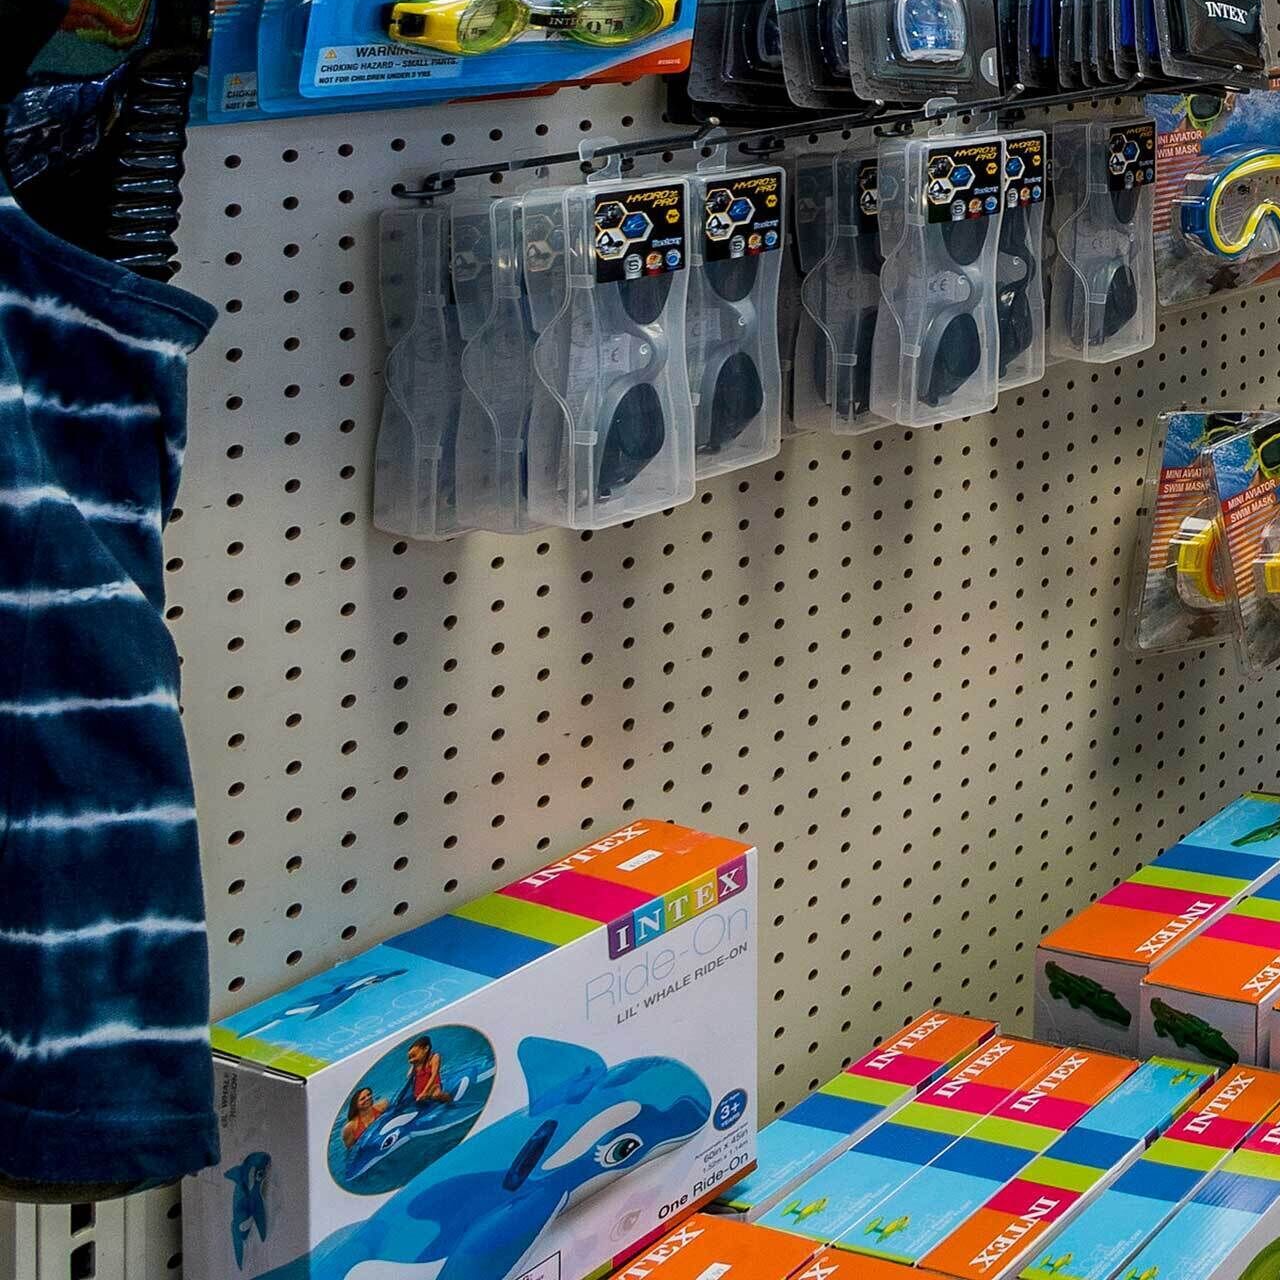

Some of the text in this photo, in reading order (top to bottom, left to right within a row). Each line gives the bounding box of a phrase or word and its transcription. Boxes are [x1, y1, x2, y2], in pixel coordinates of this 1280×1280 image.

[1205, 1, 1248, 24] INTEX
[318, 76, 333, 84] NOT
[335, 75, 350, 83] FOR
[350, 73, 386, 83] CHILDREN
[321, 61, 359, 73] CHOKING
[360, 59, 394, 71] HAZARD
[402, 58, 429, 68] SMALL
[1169, 129, 1203, 145] AVIATOR
[1174, 143, 1199, 156] MASK
[652, 196, 680, 208] PRO
[1163, 483, 1185, 494] SWIM
[1165, 469, 1179, 479] MINI
[1227, 479, 1277, 510] MINI AVIATOR
[1230, 495, 1274, 523] SWIM MASK
[519, 822, 651, 889] INTEX
[616, 866, 745, 953] INTEX
[1134, 900, 1218, 958] INTEX
[584, 907, 749, 1021] Ride-On
[616, 941, 748, 1025] LIL' WHALE RIDE-ON
[866, 1014, 949, 1071] INTEX
[933, 1042, 1015, 1099] INTEX
[1010, 1055, 1090, 1113] INTEX
[718, 1099, 741, 1121] 3+
[1183, 1073, 1257, 1135] INTEX
[702, 1145, 722, 1164] 60in
[657, 1150, 750, 1221] One Ride-On
[616, 1221, 706, 1280] TEX
[968, 1196, 1061, 1273] INTEX
